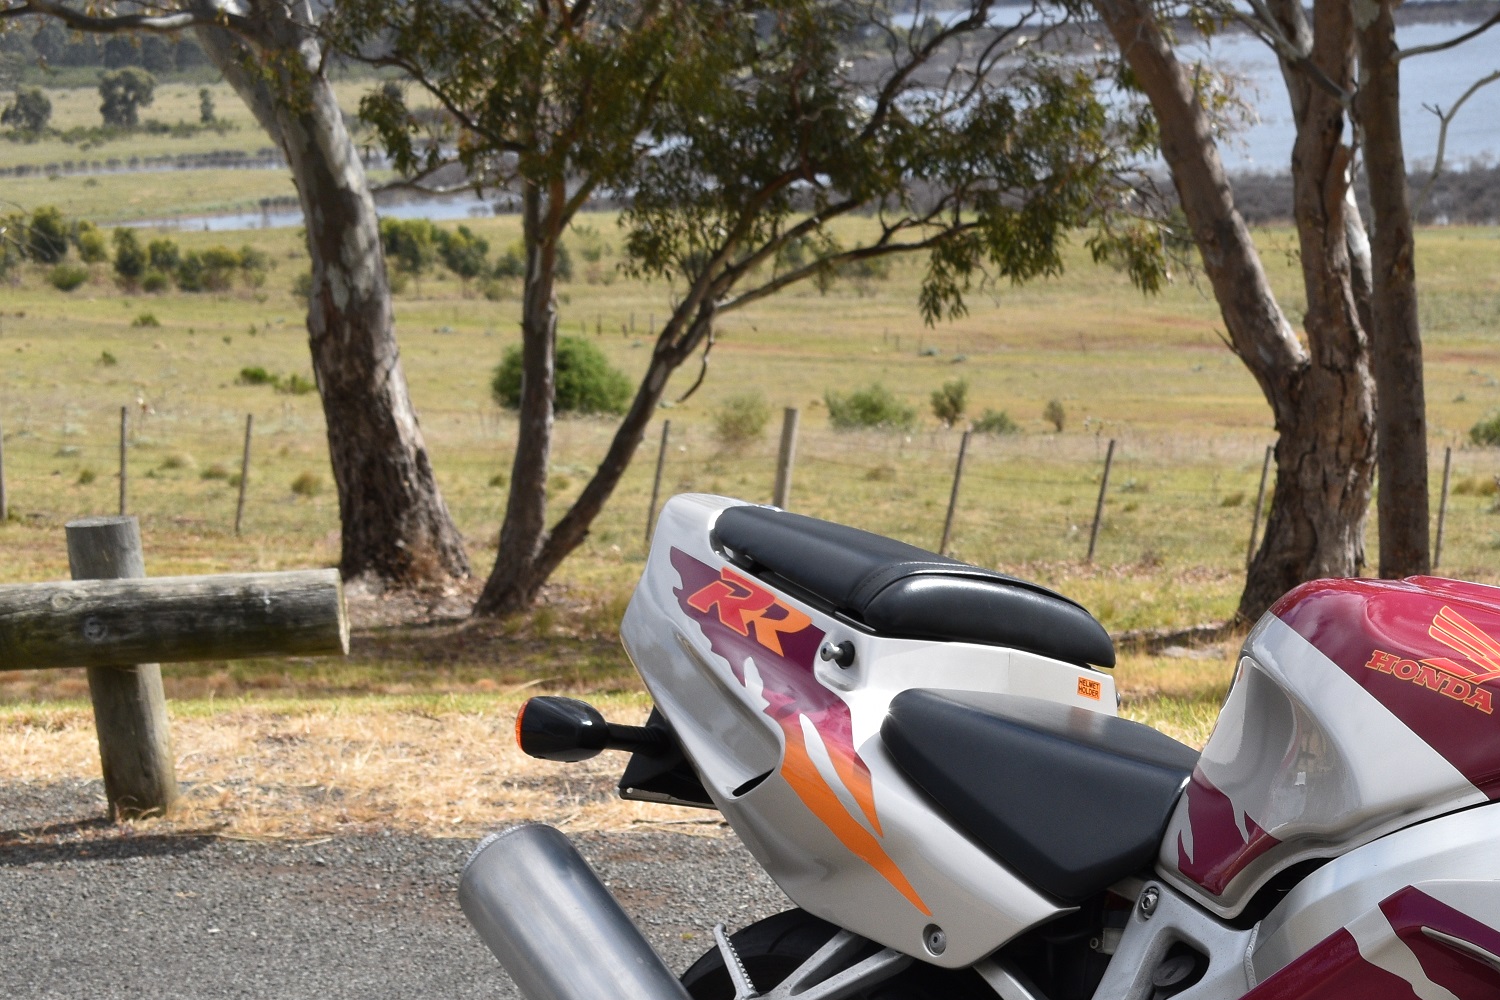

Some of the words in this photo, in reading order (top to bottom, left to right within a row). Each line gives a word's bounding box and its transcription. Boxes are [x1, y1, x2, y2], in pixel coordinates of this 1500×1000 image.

[688, 567, 812, 657] RR
[1079, 679, 1099, 689] HELMET
[1079, 686, 1099, 697] HOLDER
[1365, 650, 1494, 714] HONDA
